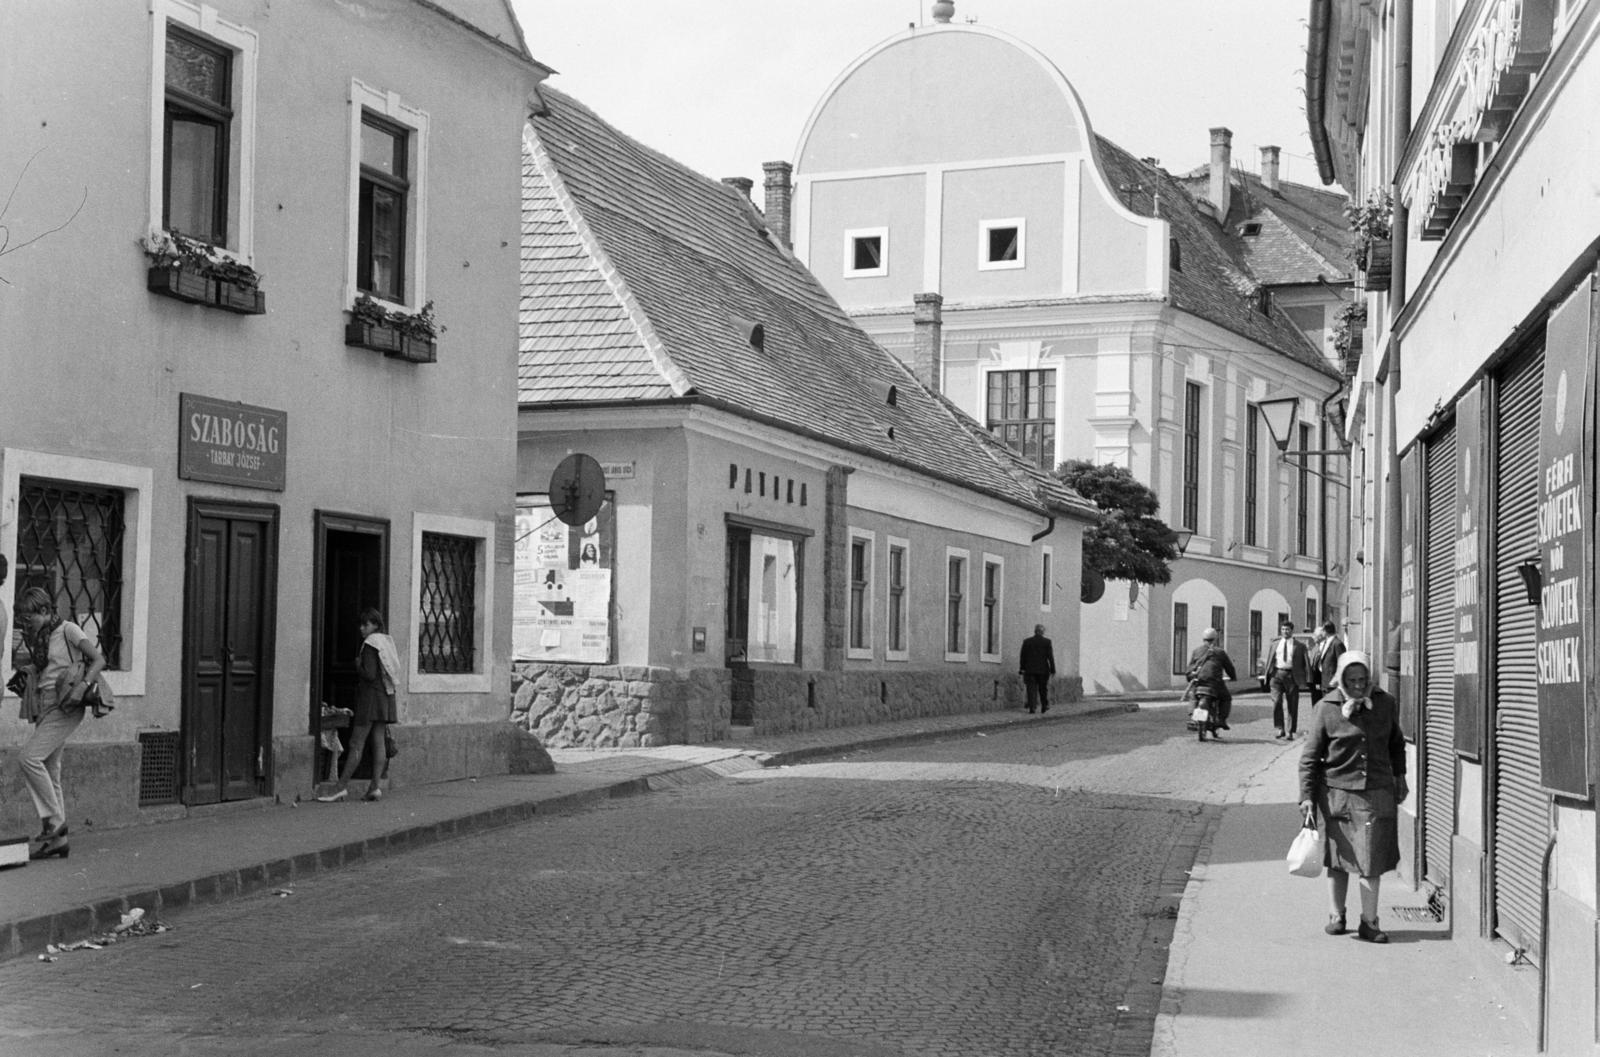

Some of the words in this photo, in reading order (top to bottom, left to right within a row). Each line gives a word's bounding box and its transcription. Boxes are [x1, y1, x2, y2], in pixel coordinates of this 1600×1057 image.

[190, 412, 279, 454] SZABÓSÁG
[729, 463, 808, 507] PATIKA
[1545, 453, 1574, 495] FÉRFI
[1539, 484, 1581, 544] SZÖVETEK
[1550, 541, 1564, 571] NŐI
[1541, 576, 1579, 630] SZÖVETEK
[1538, 636, 1580, 685] SELYMEK
